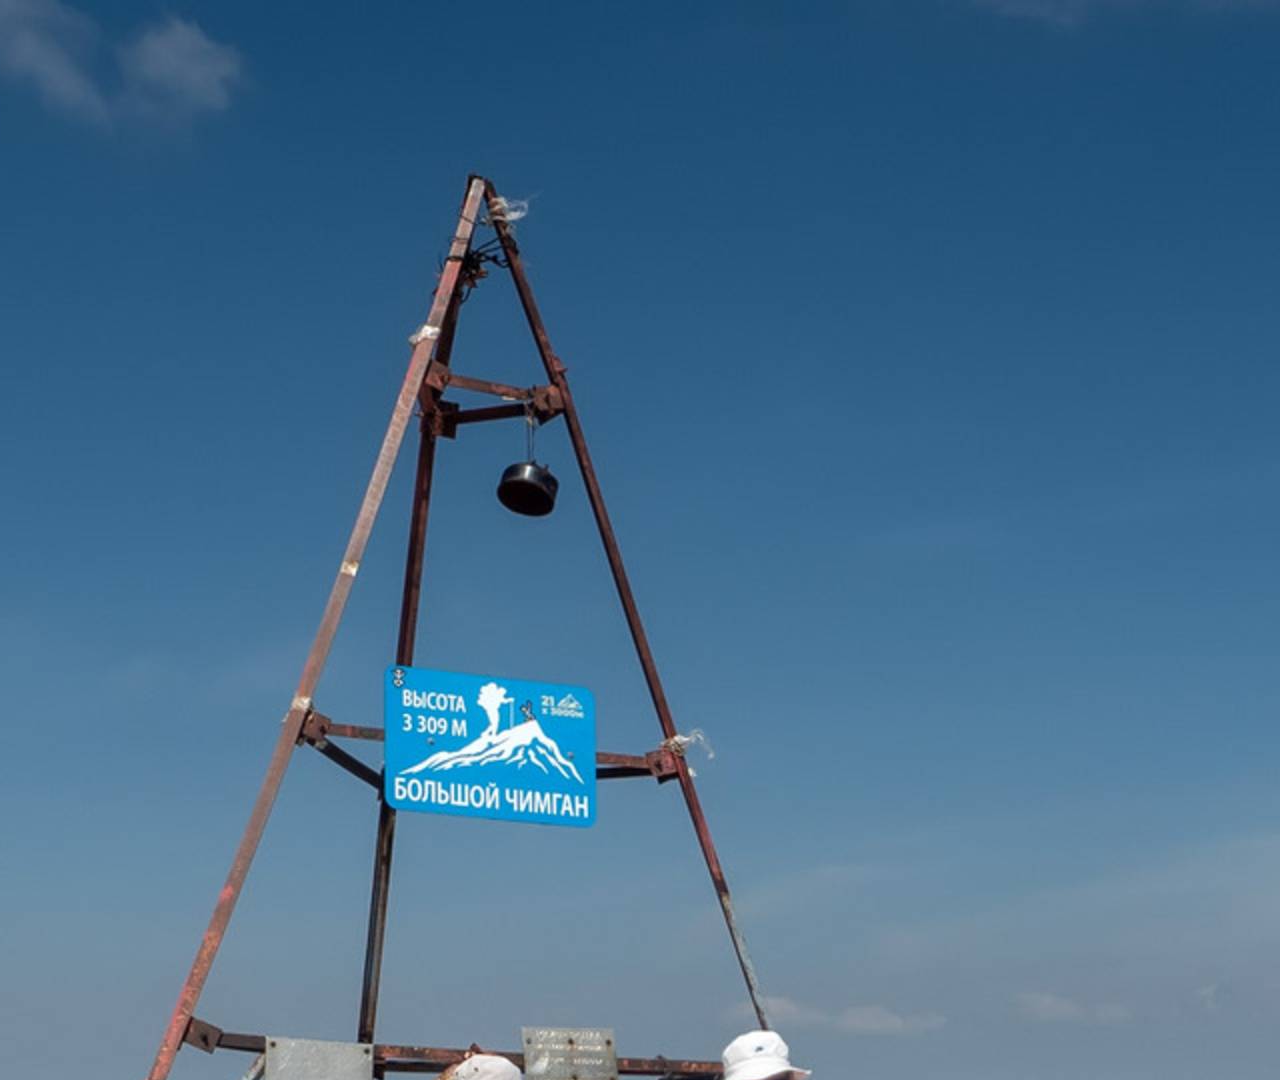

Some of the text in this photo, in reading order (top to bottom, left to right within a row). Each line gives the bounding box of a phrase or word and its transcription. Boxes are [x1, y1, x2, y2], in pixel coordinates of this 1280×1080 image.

[402, 688, 467, 713] ВЫСОТА
[402, 714, 468, 737] 3 309 М
[394, 777, 589, 818] БОЛЬШОЙ ЧИМГАН
